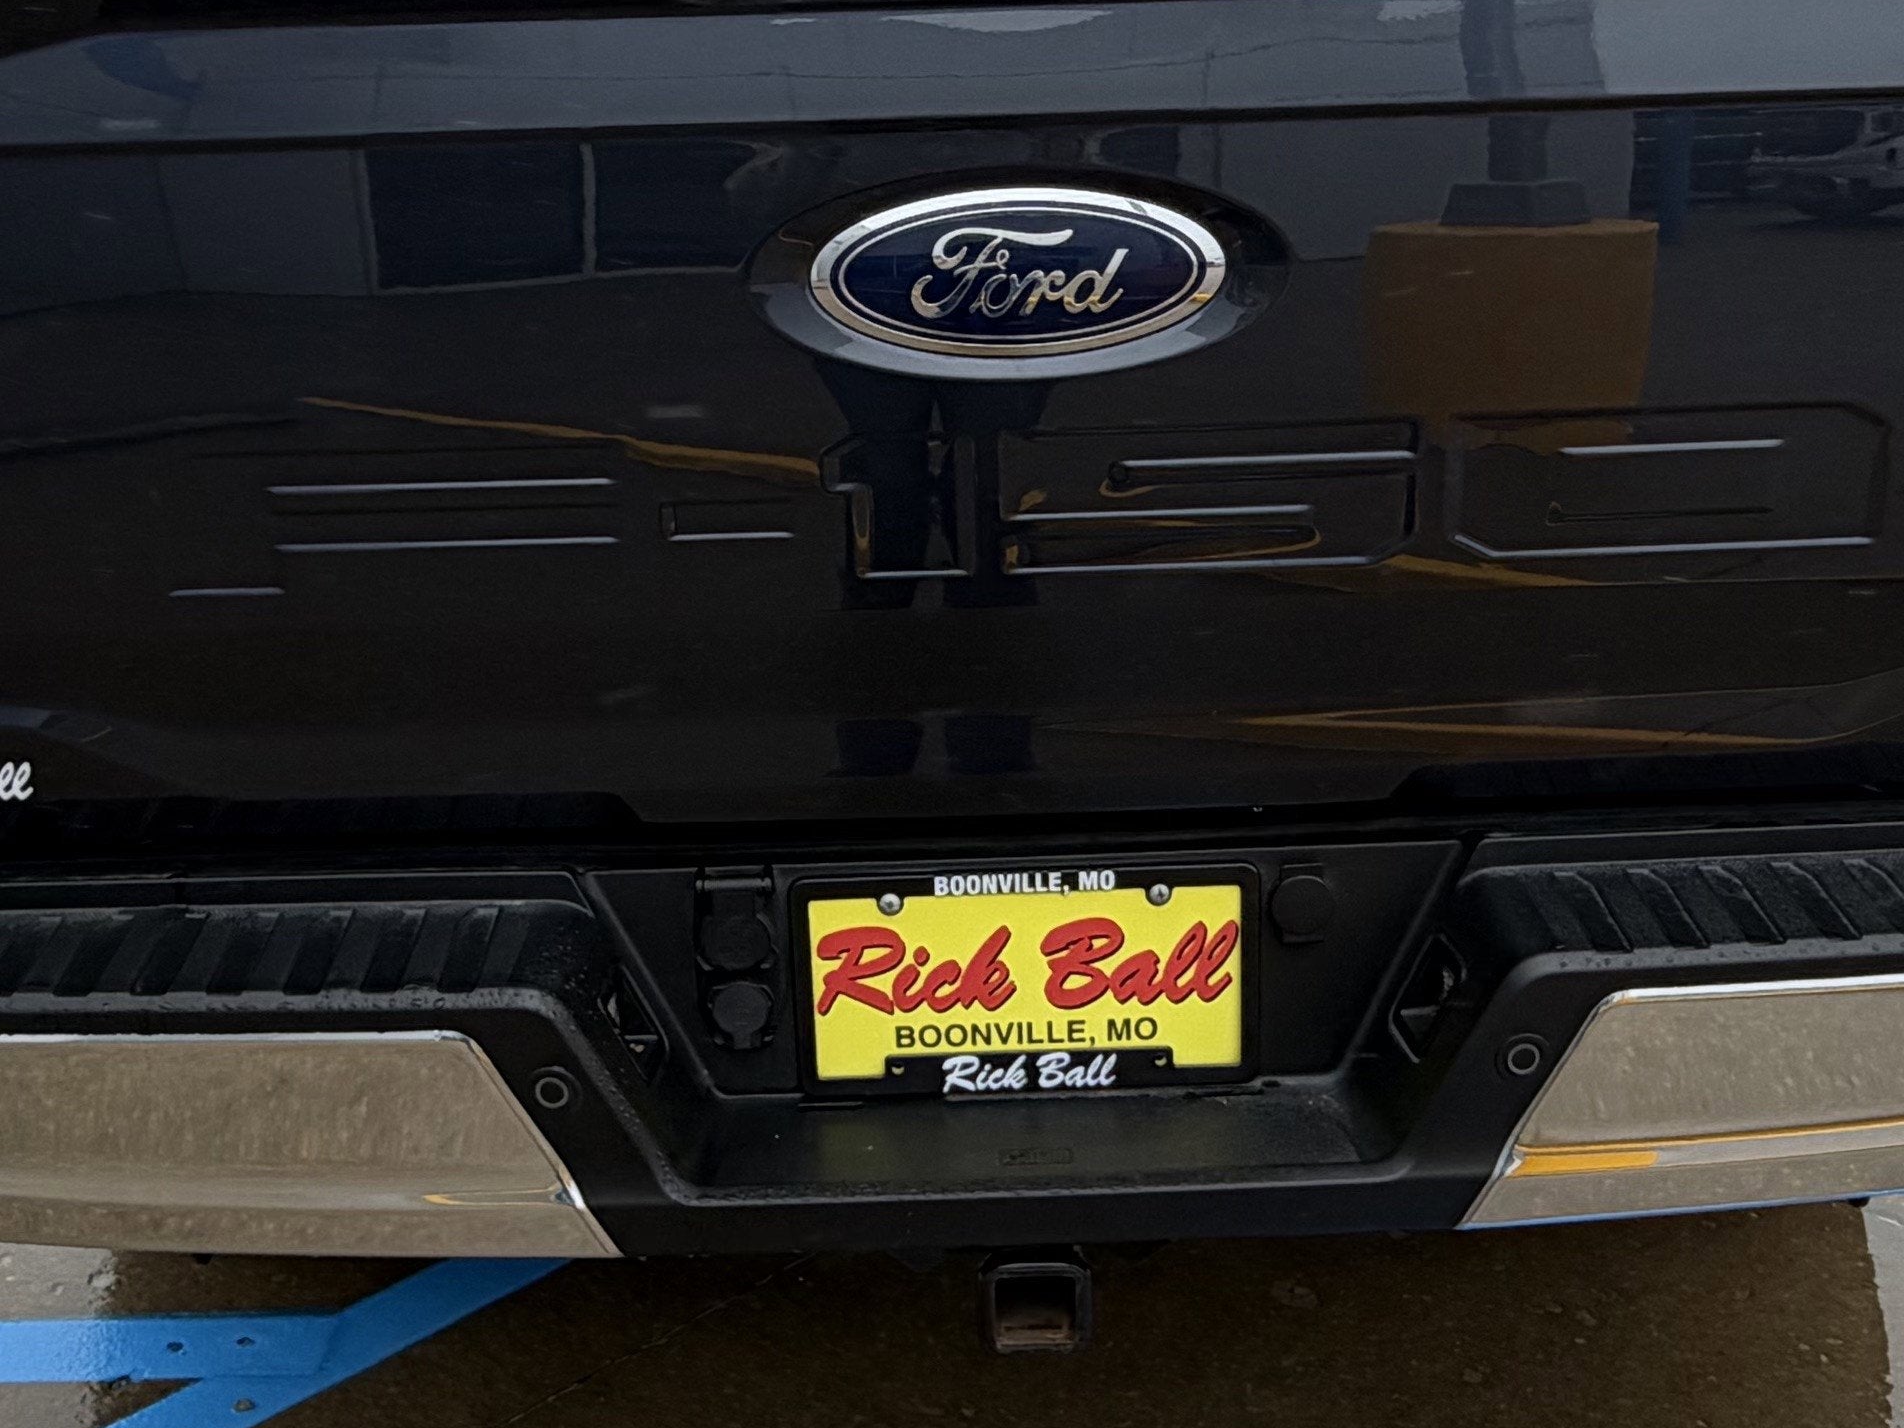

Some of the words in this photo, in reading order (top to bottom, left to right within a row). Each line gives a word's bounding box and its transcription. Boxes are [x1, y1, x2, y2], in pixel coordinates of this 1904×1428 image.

[909, 227, 1130, 319] Ford
[933, 872, 1070, 897] BOONVILLE,
[1078, 870, 1115, 891] MO
[815, 925, 1017, 1016] Rick
[1040, 917, 1239, 1010] Ball
[895, 1019, 1095, 1048] BOONVILLE,
[1107, 1017, 1158, 1041] MO
[942, 1055, 1029, 1093] Rick
[1035, 1052, 1117, 1088] Ball
